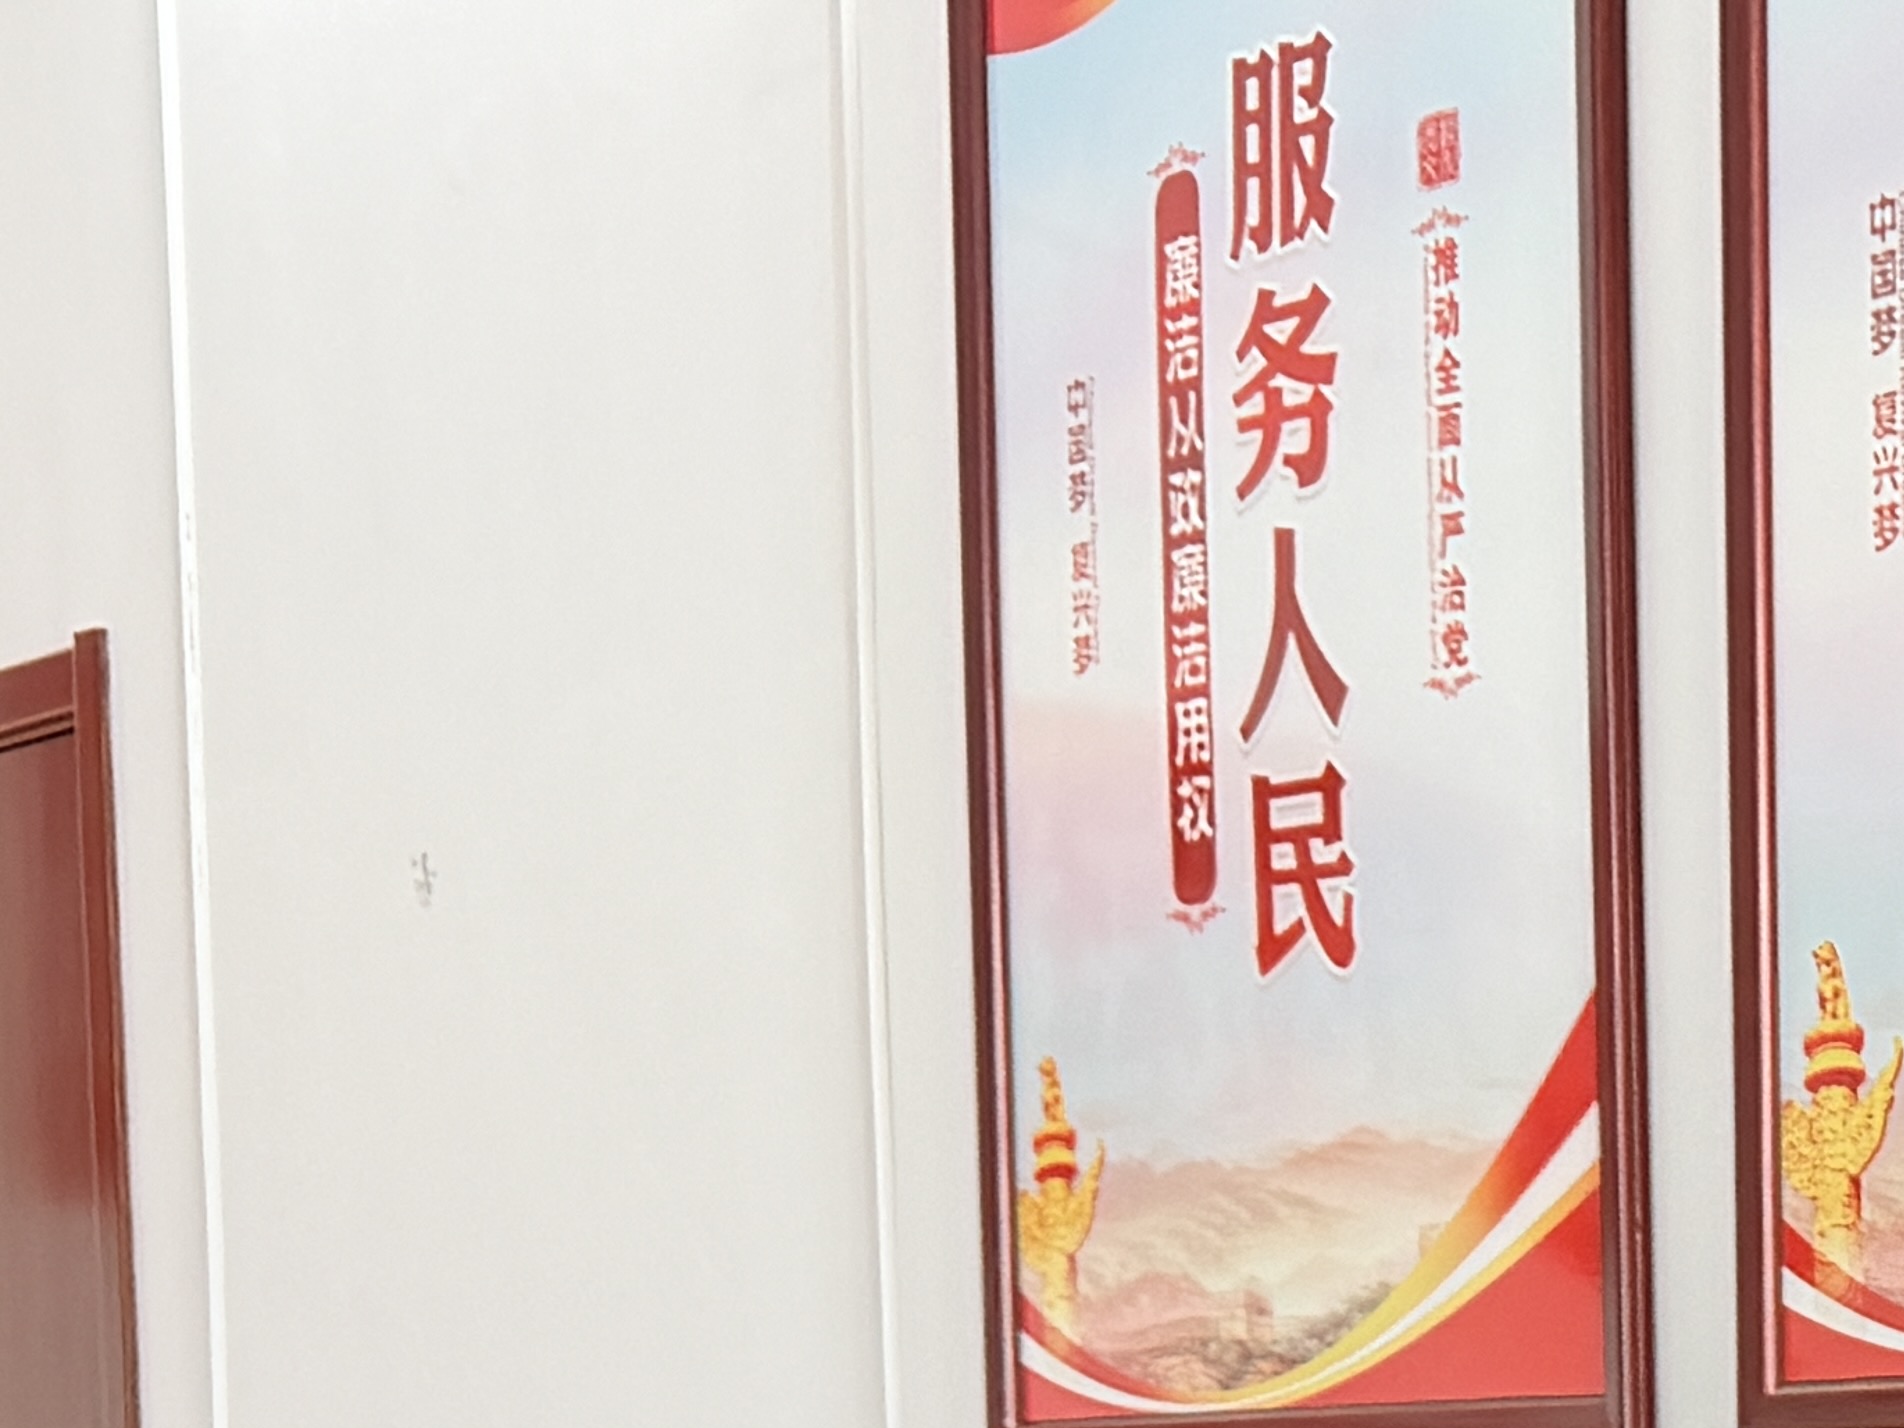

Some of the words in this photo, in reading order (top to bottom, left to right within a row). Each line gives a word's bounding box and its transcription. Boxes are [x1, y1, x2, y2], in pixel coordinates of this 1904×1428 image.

[1869, 192, 1897, 356] 中国梦
[1164, 235, 1214, 842] 廉洁从政廉洁用权
[1229, 31, 1355, 978] 服务人民
[1872, 391, 1900, 552] 复兴梦
